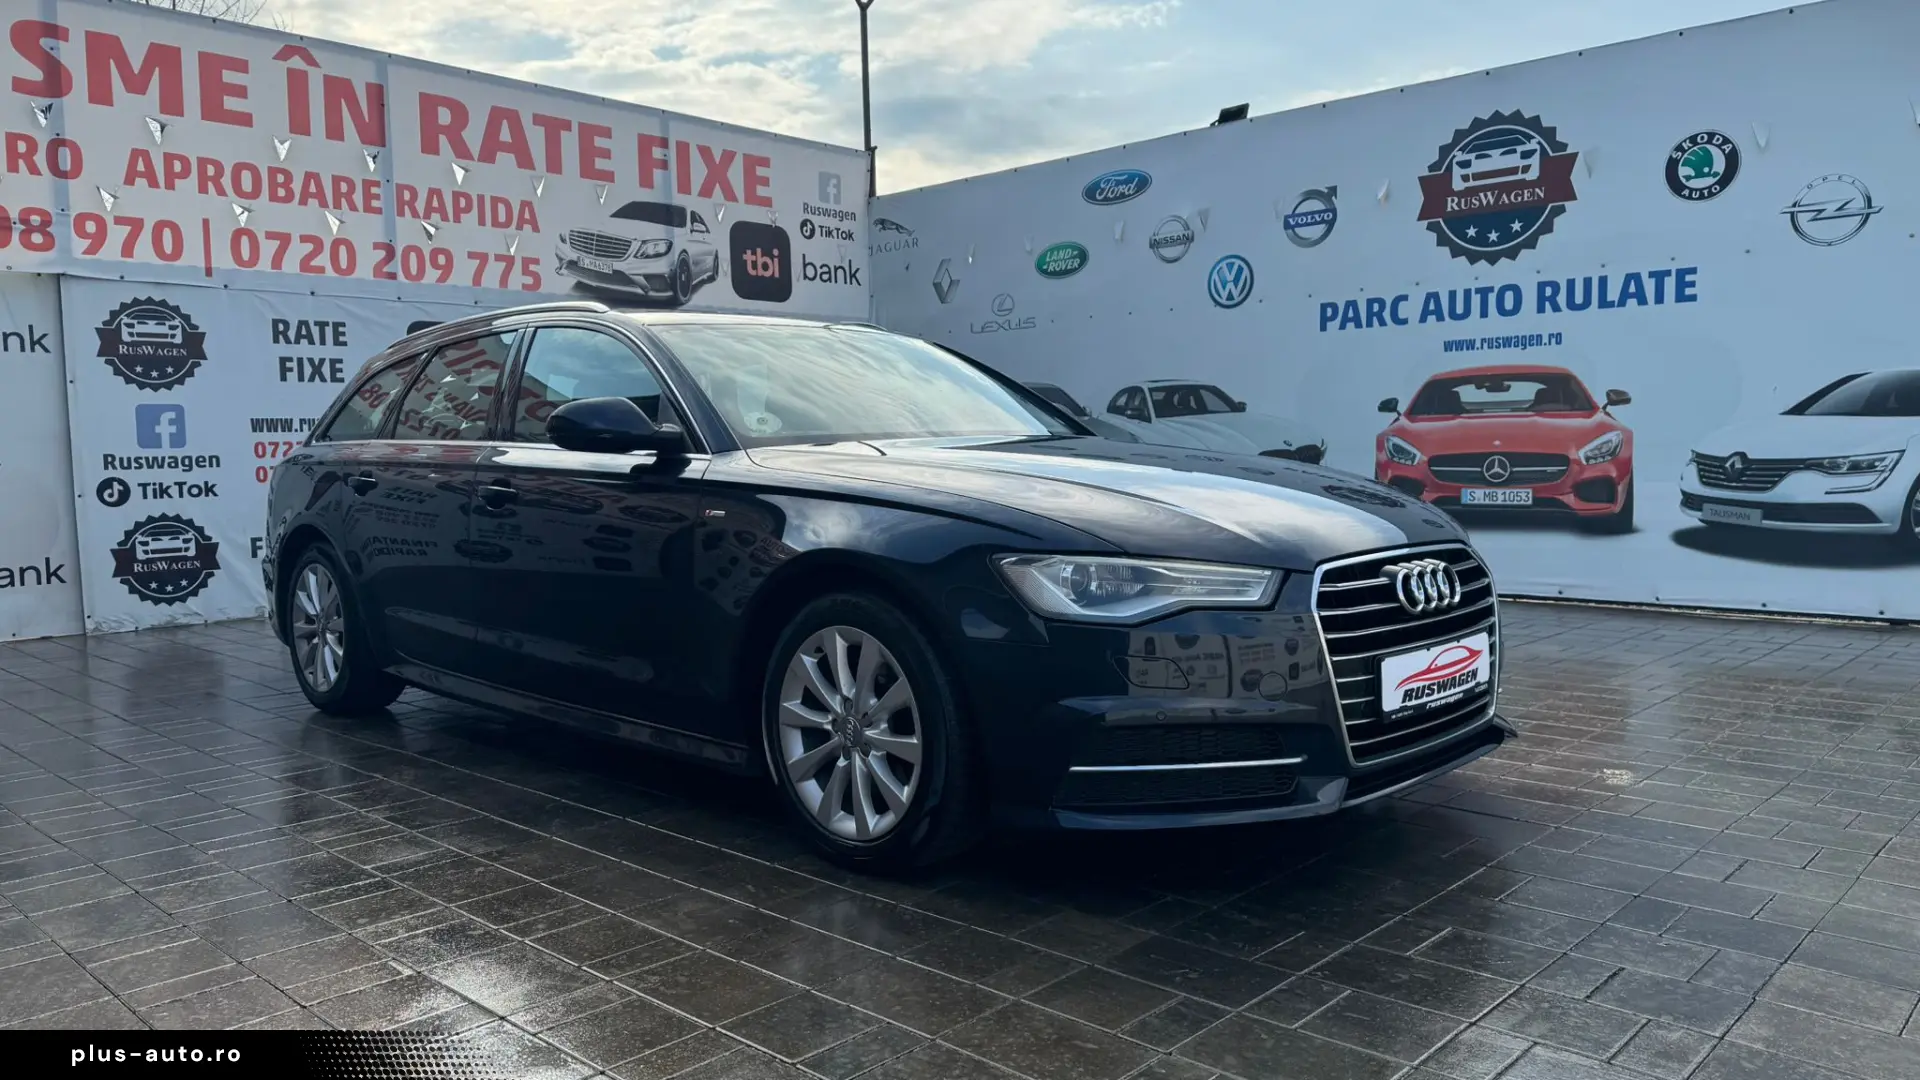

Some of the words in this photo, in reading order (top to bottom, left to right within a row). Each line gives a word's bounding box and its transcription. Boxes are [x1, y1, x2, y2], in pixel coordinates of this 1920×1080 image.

[9, 19, 254, 128] SME
[272, 44, 386, 147] ÎN
[418, 92, 615, 184] RATE
[637, 133, 773, 207] FIXE
[5, 132, 83, 180] RO
[123, 147, 384, 216] APROBARE
[395, 183, 541, 234] RAPIDA
[1096, 174, 1139, 200] Ford
[1681, 184, 1721, 199] AUTO
[1806, 175, 1858, 190] OPEL
[802, 202, 857, 223] Ruswagen
[1287, 211, 1333, 226] VOLVO
[818, 225, 855, 242] TikTok
[1152, 231, 1191, 246] NISSAN
[73, 212, 184, 262] 970
[230, 227, 357, 277] 0720
[372, 242, 454, 284] 209
[467, 250, 542, 292] 775
[868, 237, 919, 257] JAGUAR
[743, 248, 780, 278] tbi
[802, 253, 862, 287] bank
[1319, 293, 1409, 333] PARC
[1418, 283, 1523, 324] AUTO
[1536, 266, 1699, 315] RULATE
[271, 318, 348, 347] RATE
[970, 316, 1037, 335] LEXUS
[1443, 331, 1563, 353] www.ruswagen.ro
[278, 356, 345, 384] FIXE
[253, 441, 303, 459] 072
[103, 453, 221, 472] Ruswagen
[137, 480, 219, 500] TikTok
[1401, 667, 1479, 704] RUSWAGEN
